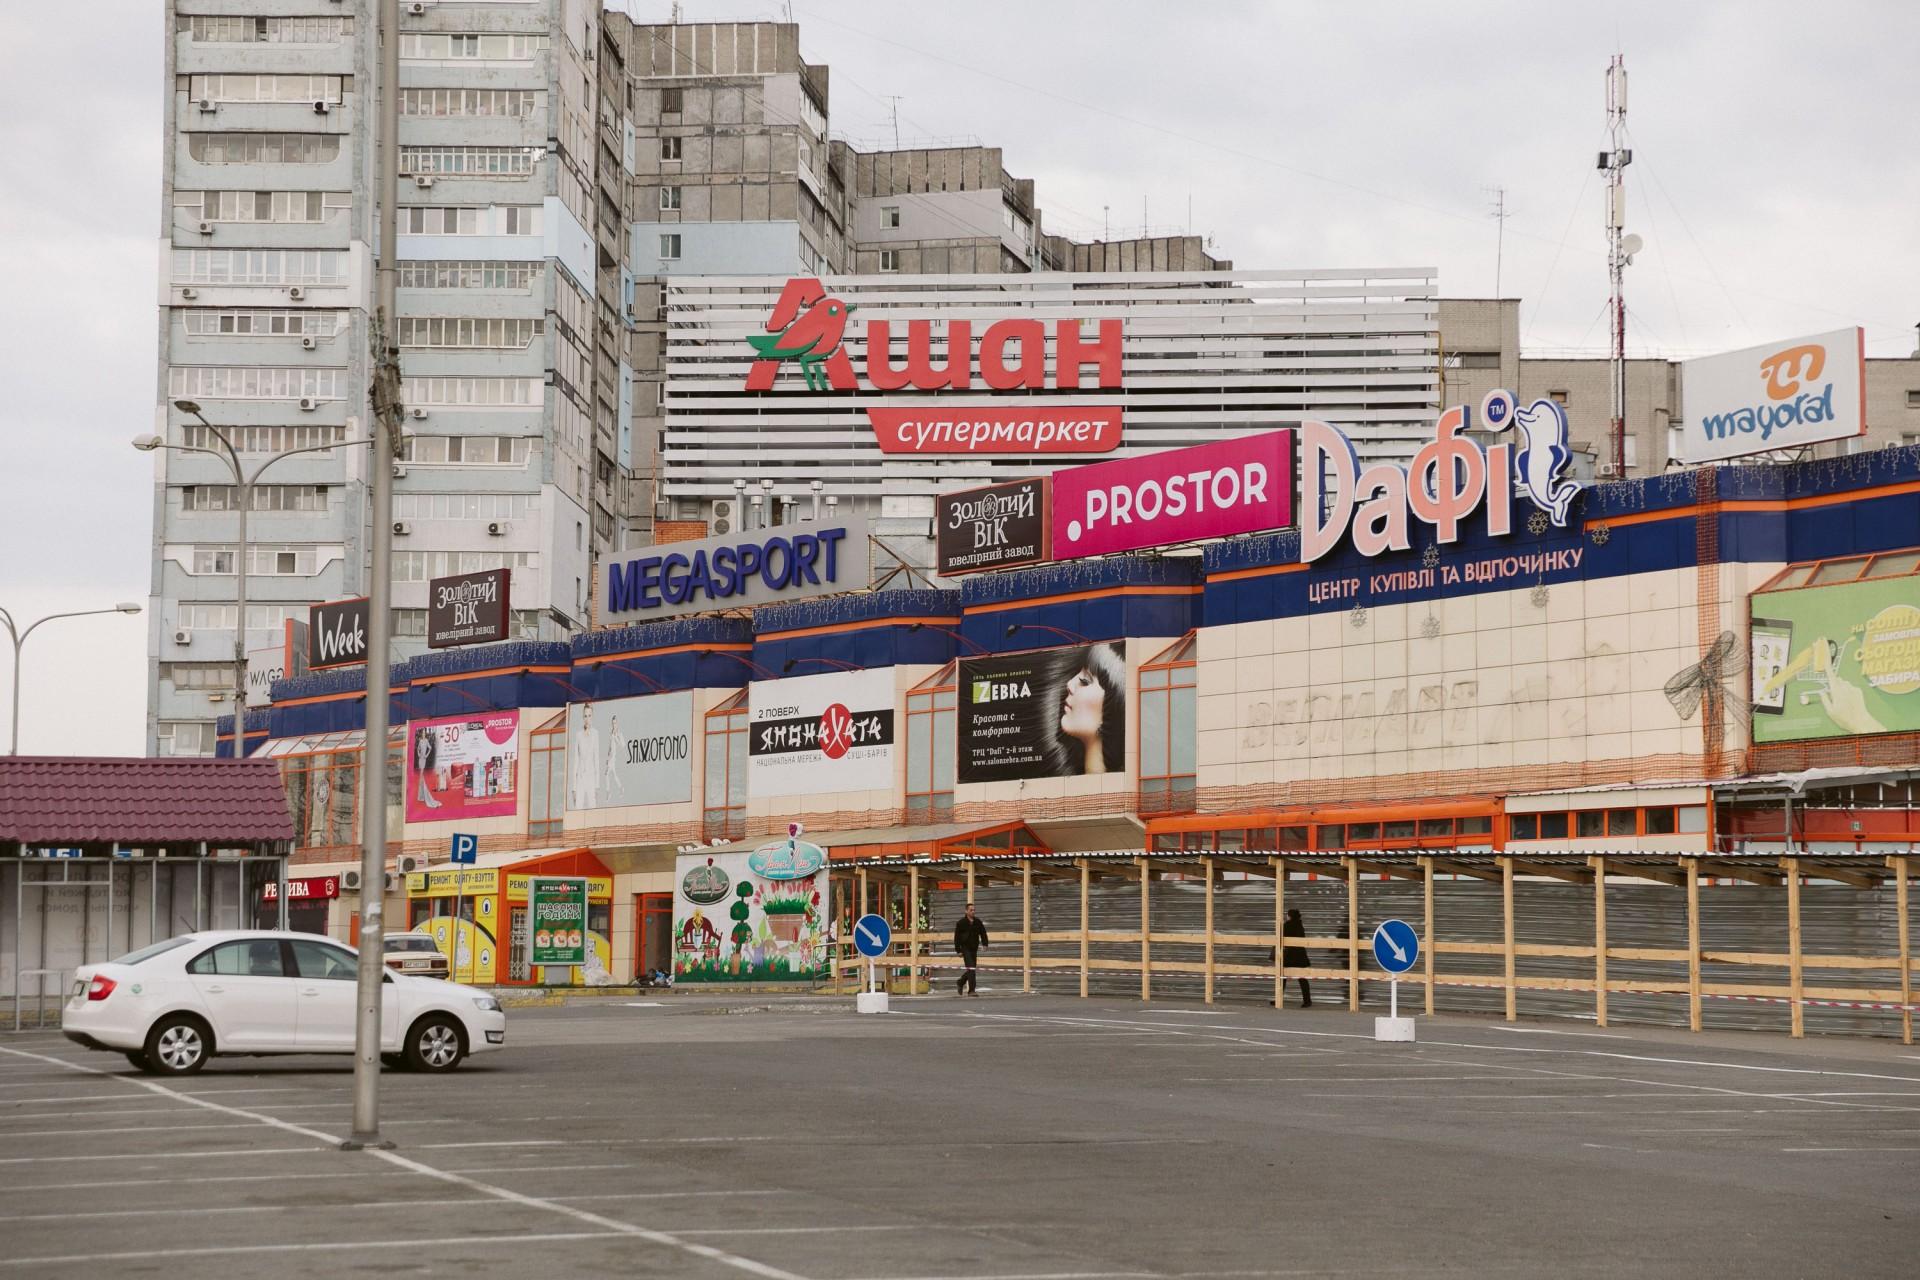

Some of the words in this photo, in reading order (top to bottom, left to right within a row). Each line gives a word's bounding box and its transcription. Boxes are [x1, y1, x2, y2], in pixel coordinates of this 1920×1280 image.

[745, 278, 1123, 391] Ашан
[1702, 383, 1835, 441] mayoral
[897, 419, 1109, 450] супермаркет
[974, 516, 1009, 548] ВІК
[948, 547, 1002, 567] ювелірний
[1004, 545, 1035, 559] завод
[608, 527, 846, 614] MEGASPORT
[1309, 578, 1361, 604] ЦЕНТР
[1370, 568, 1435, 595] КУПІВЛІ
[1440, 565, 1461, 585] ТА
[1464, 548, 1584, 583] ВІДПОЧИНКУ
[454, 600, 479, 626] ВІК
[318, 611, 366, 661] Week
[435, 626, 474, 641] ювелірний
[475, 625, 496, 635] завод
[977, 681, 1032, 703] ZEBRA
[758, 709, 764, 719] 2
[766, 705, 800, 719] ПОВЕРХ
[972, 713, 1008, 726] Красота
[1010, 713, 1015, 721] с
[972, 726, 1021, 738] комфортом
[756, 756, 796, 767] НАЦІОНАЛЬНА
[798, 754, 822, 764] МЕРЕЖА
[847, 748, 888, 760] СУШІ-БАРІВ
[972, 749, 985, 757] ТРЦ
[972, 755, 1043, 766] www.salonzebra.com.ua
[458, 836, 473, 859] P
[430, 874, 451, 885] РЕМОНТ
[509, 879, 528, 889] РЕМО
[587, 882, 605, 893] ДЯГУ
[537, 902, 582, 912] ЩАСЛИВІ
[537, 910, 582, 920] ГОДИНИ
